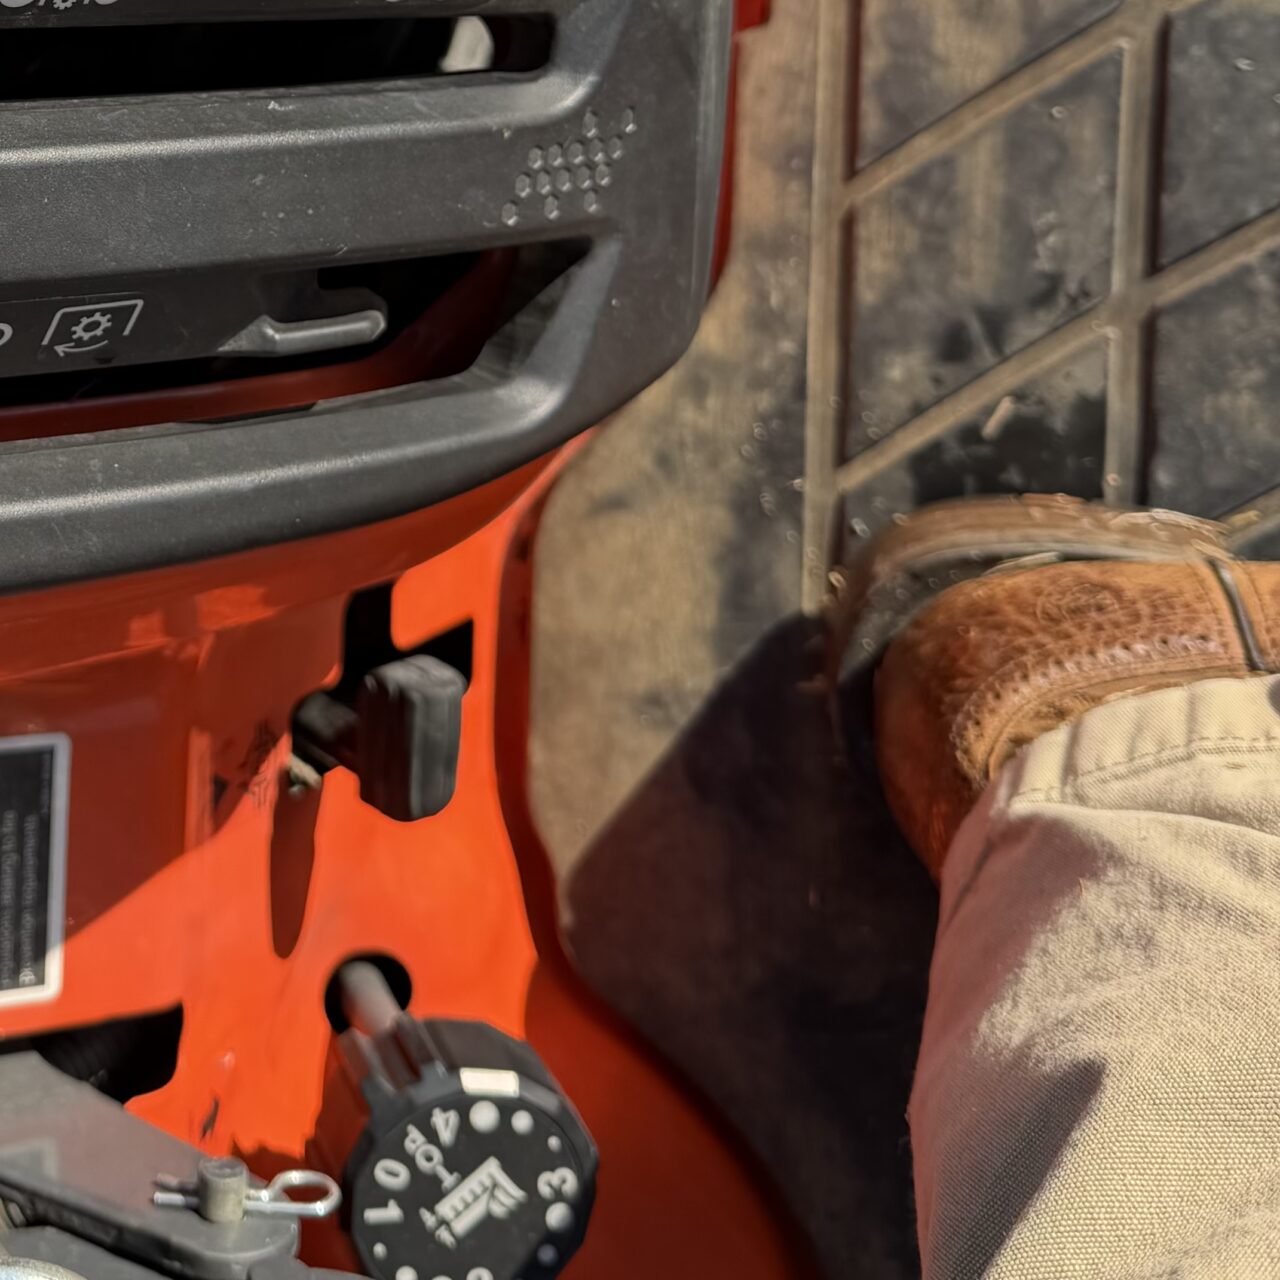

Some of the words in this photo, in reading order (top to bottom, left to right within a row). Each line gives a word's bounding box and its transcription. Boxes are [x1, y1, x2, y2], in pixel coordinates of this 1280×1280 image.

[431, 1107, 460, 1148] 4
[537, 1167, 578, 1202] 3
[364, 1198, 404, 1224] 1
